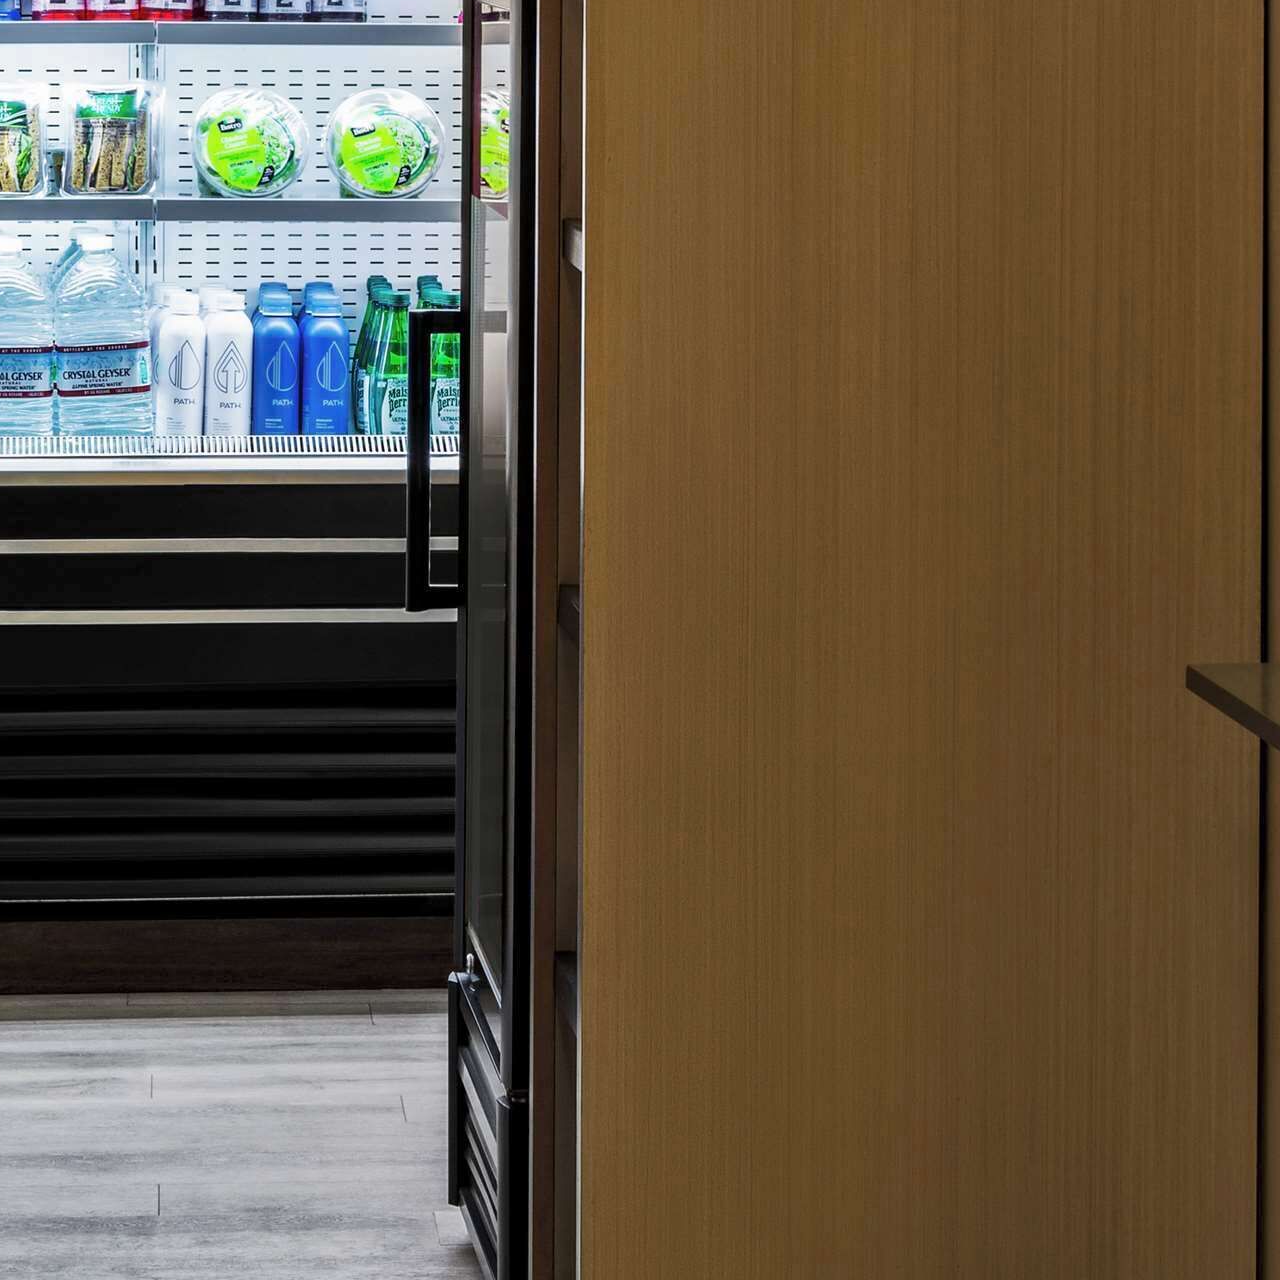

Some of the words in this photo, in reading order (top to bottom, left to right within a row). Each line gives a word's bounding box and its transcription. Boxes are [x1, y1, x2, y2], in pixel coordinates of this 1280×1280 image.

[11, 372, 43, 382] GEYSER
[62, 370, 96, 381] CRYSTAL
[97, 368, 131, 379] GEYSER
[388, 387, 408, 399] Mais
[437, 387, 457, 398] Mais
[437, 397, 458, 417] Perri
